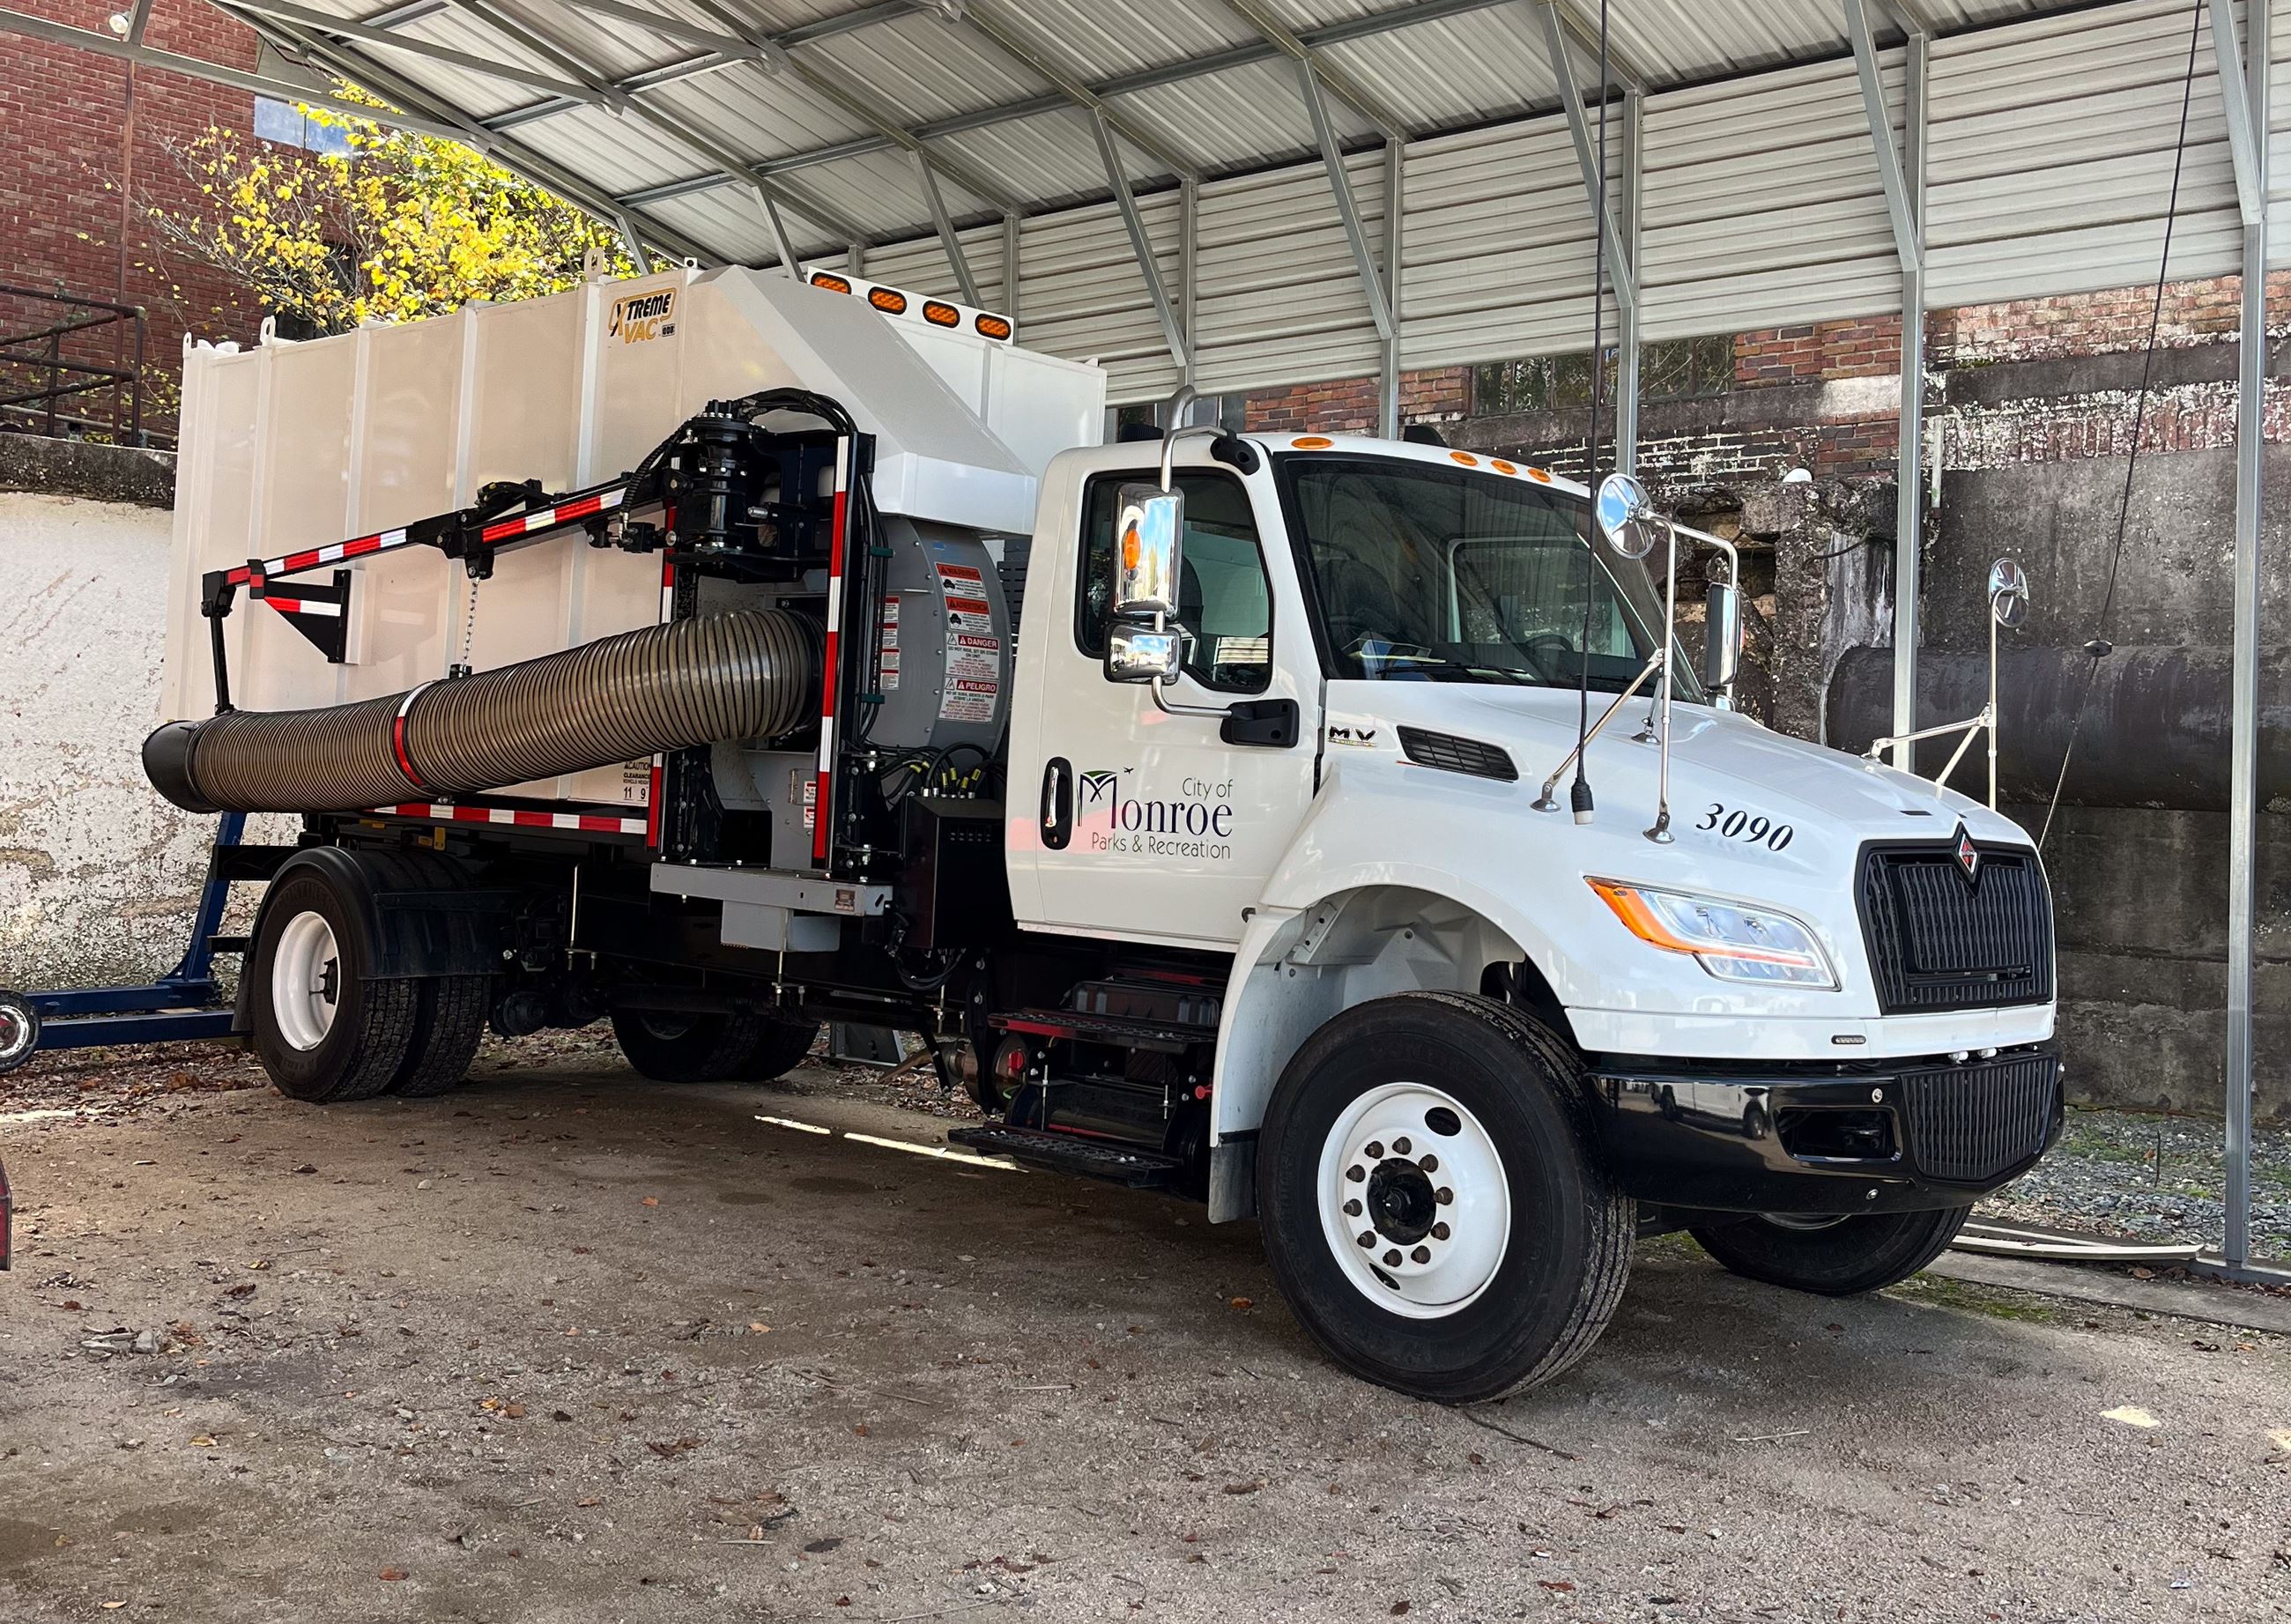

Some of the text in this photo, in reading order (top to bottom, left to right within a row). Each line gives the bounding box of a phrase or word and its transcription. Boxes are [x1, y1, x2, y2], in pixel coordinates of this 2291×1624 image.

[610, 293, 672, 337] XTREME
[624, 318, 658, 344] VAC
[967, 637, 997, 649] DANGER
[965, 682, 997, 693] PELIGRO
[1329, 725, 1376, 741] MV
[624, 786, 646, 800] 11 9
[1183, 777, 1234, 801] City of
[1076, 772, 1233, 838] Monroe
[1695, 803, 1794, 852] 3090
[1092, 832, 1231, 859] Parks & Recreation
